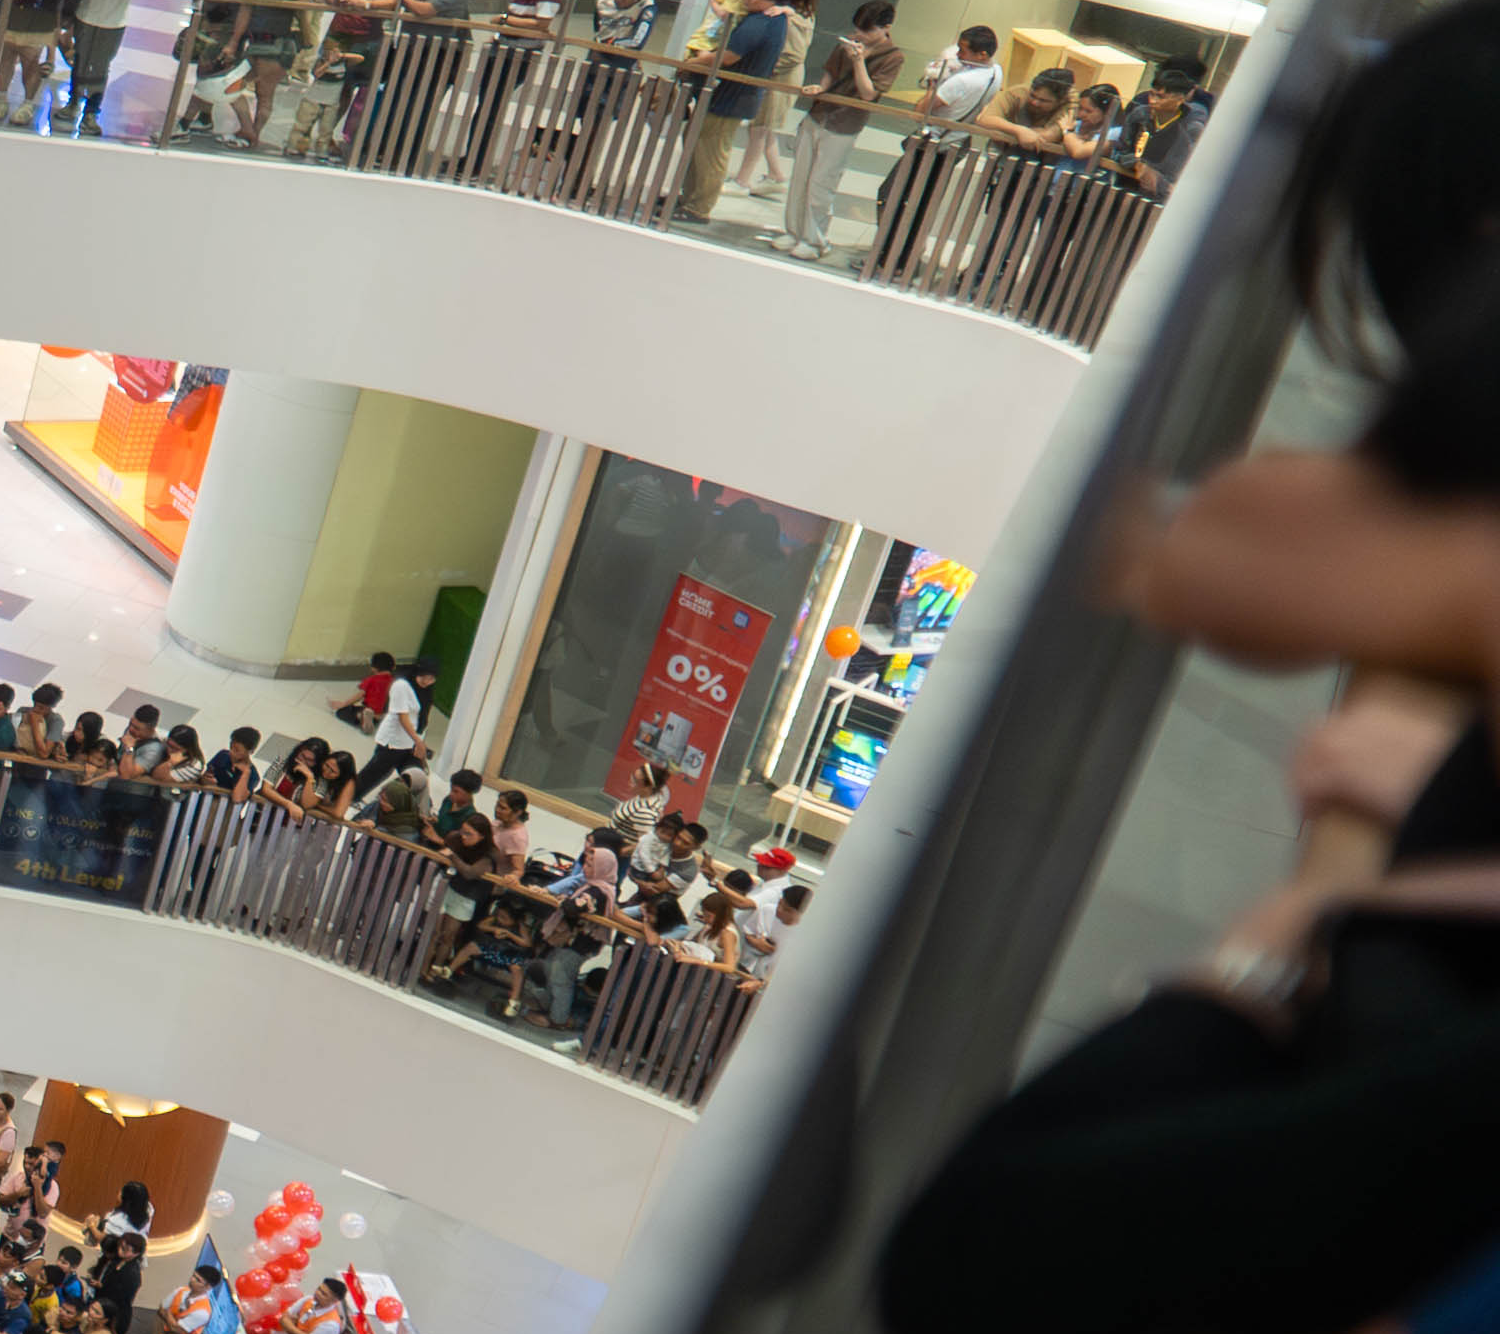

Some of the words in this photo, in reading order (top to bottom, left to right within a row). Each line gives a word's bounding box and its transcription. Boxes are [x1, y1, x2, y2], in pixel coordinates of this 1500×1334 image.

[678, 596, 716, 620] CREDIT
[681, 587, 714, 609] HOME
[666, 653, 728, 703] 0%
[14, 858, 58, 882] 4th
[59, 864, 126, 892] Level
